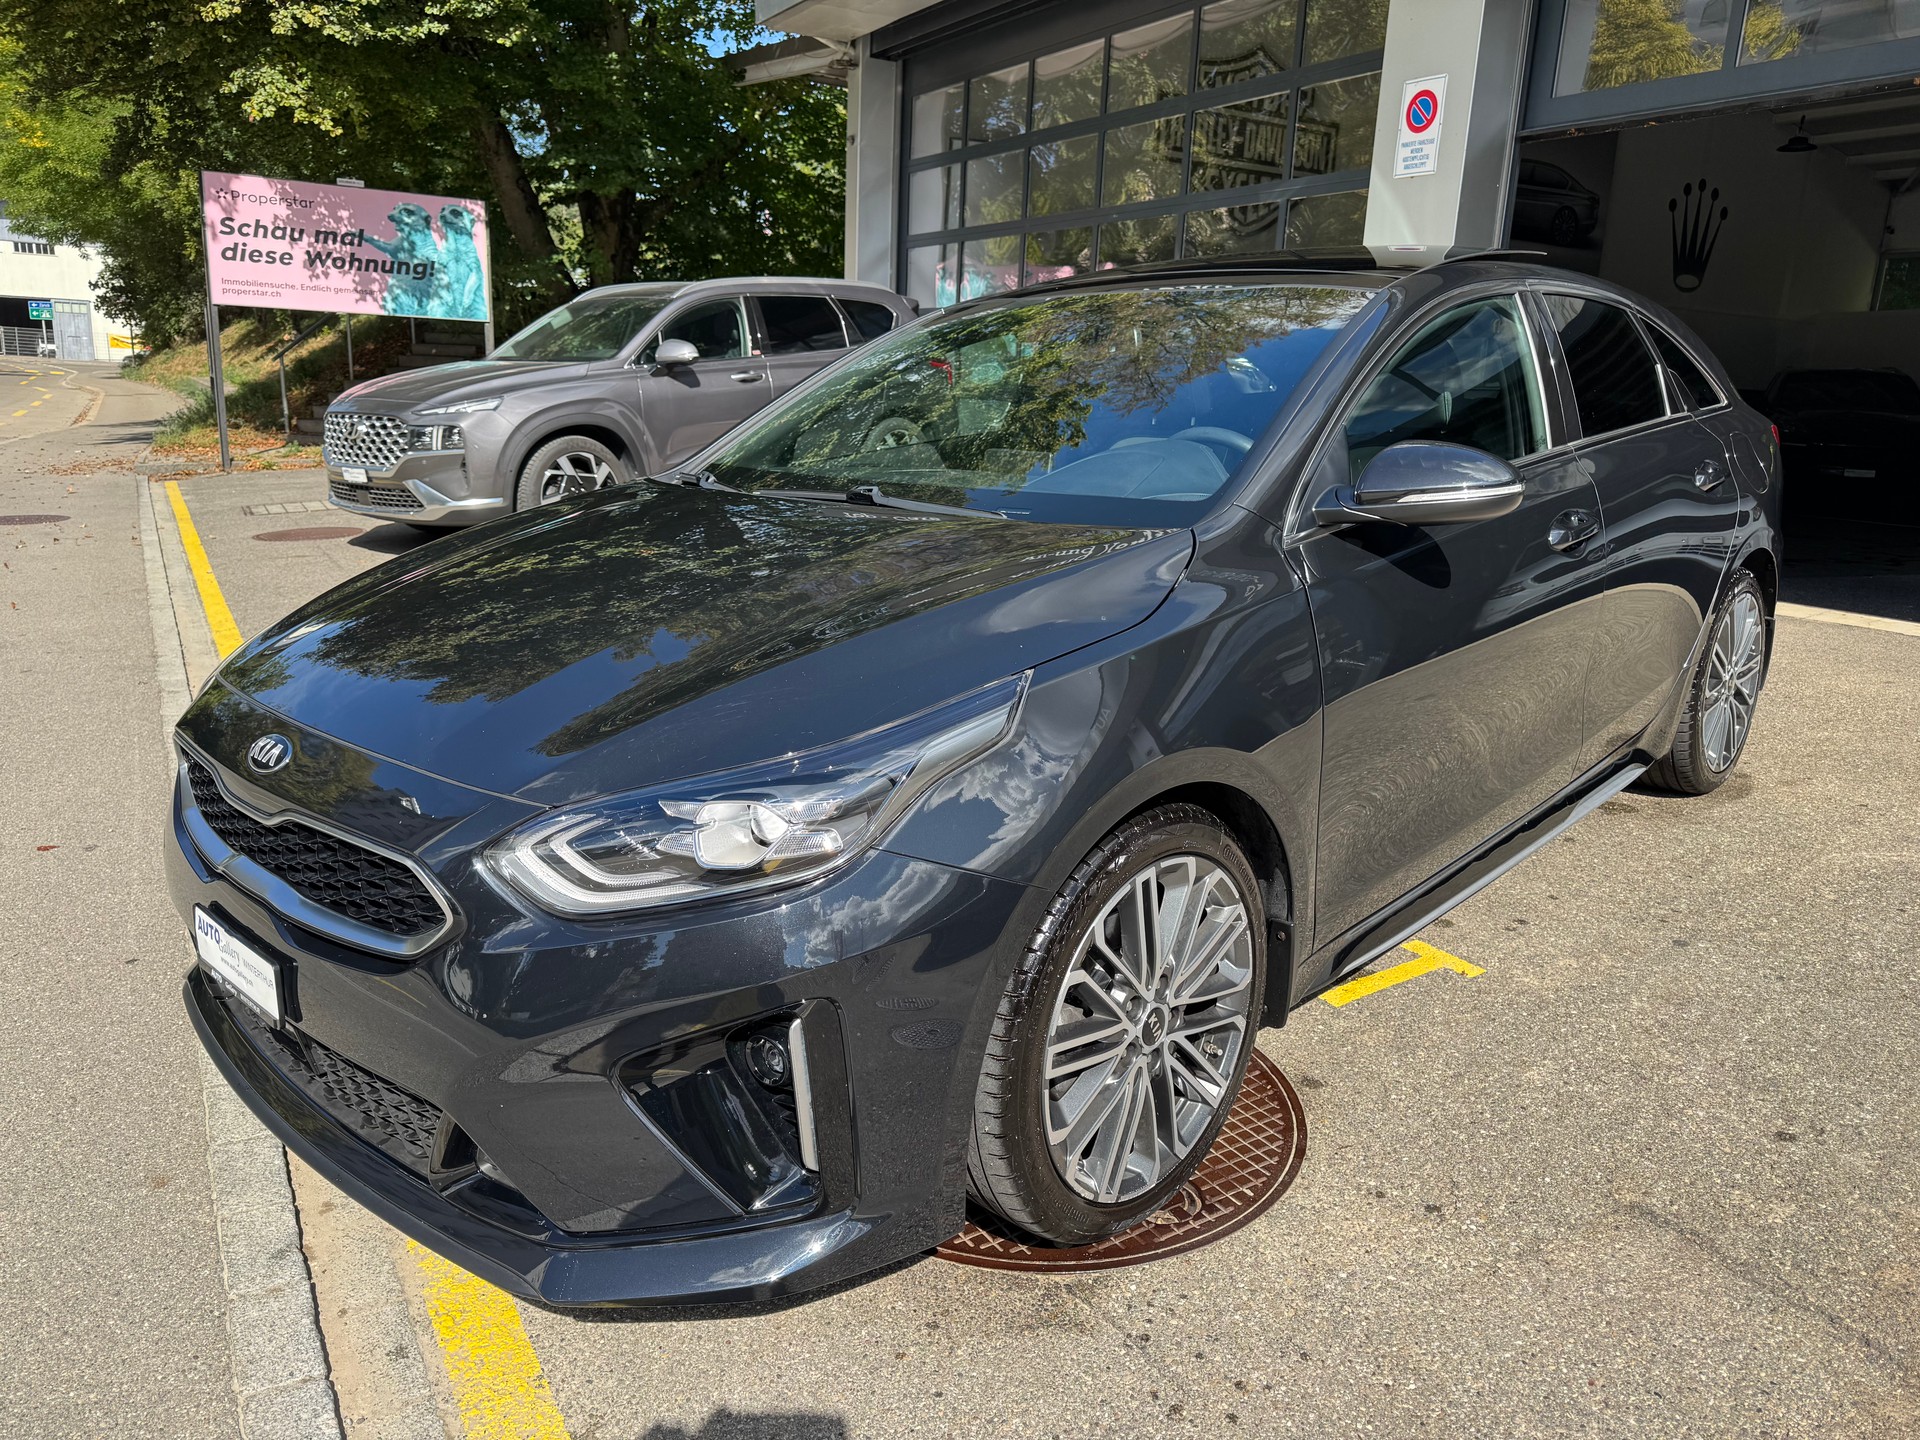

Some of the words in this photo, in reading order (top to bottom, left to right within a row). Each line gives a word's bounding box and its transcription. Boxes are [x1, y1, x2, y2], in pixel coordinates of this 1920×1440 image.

[1158, 113, 1330, 171] HARLEY-DAVISON
[230, 189, 315, 209] Properstar
[219, 216, 305, 243] Schau
[314, 229, 365, 248] mal
[220, 242, 294, 266] diese
[305, 250, 437, 281] Wohnung!
[221, 277, 299, 291] Immobiliensuche.
[300, 284, 332, 293] Endlich
[222, 287, 282, 298] properstar.ch
[250, 738, 284, 767] KIA
[198, 915, 221, 945] AUTO
[1148, 1012, 1162, 1042] KIA
